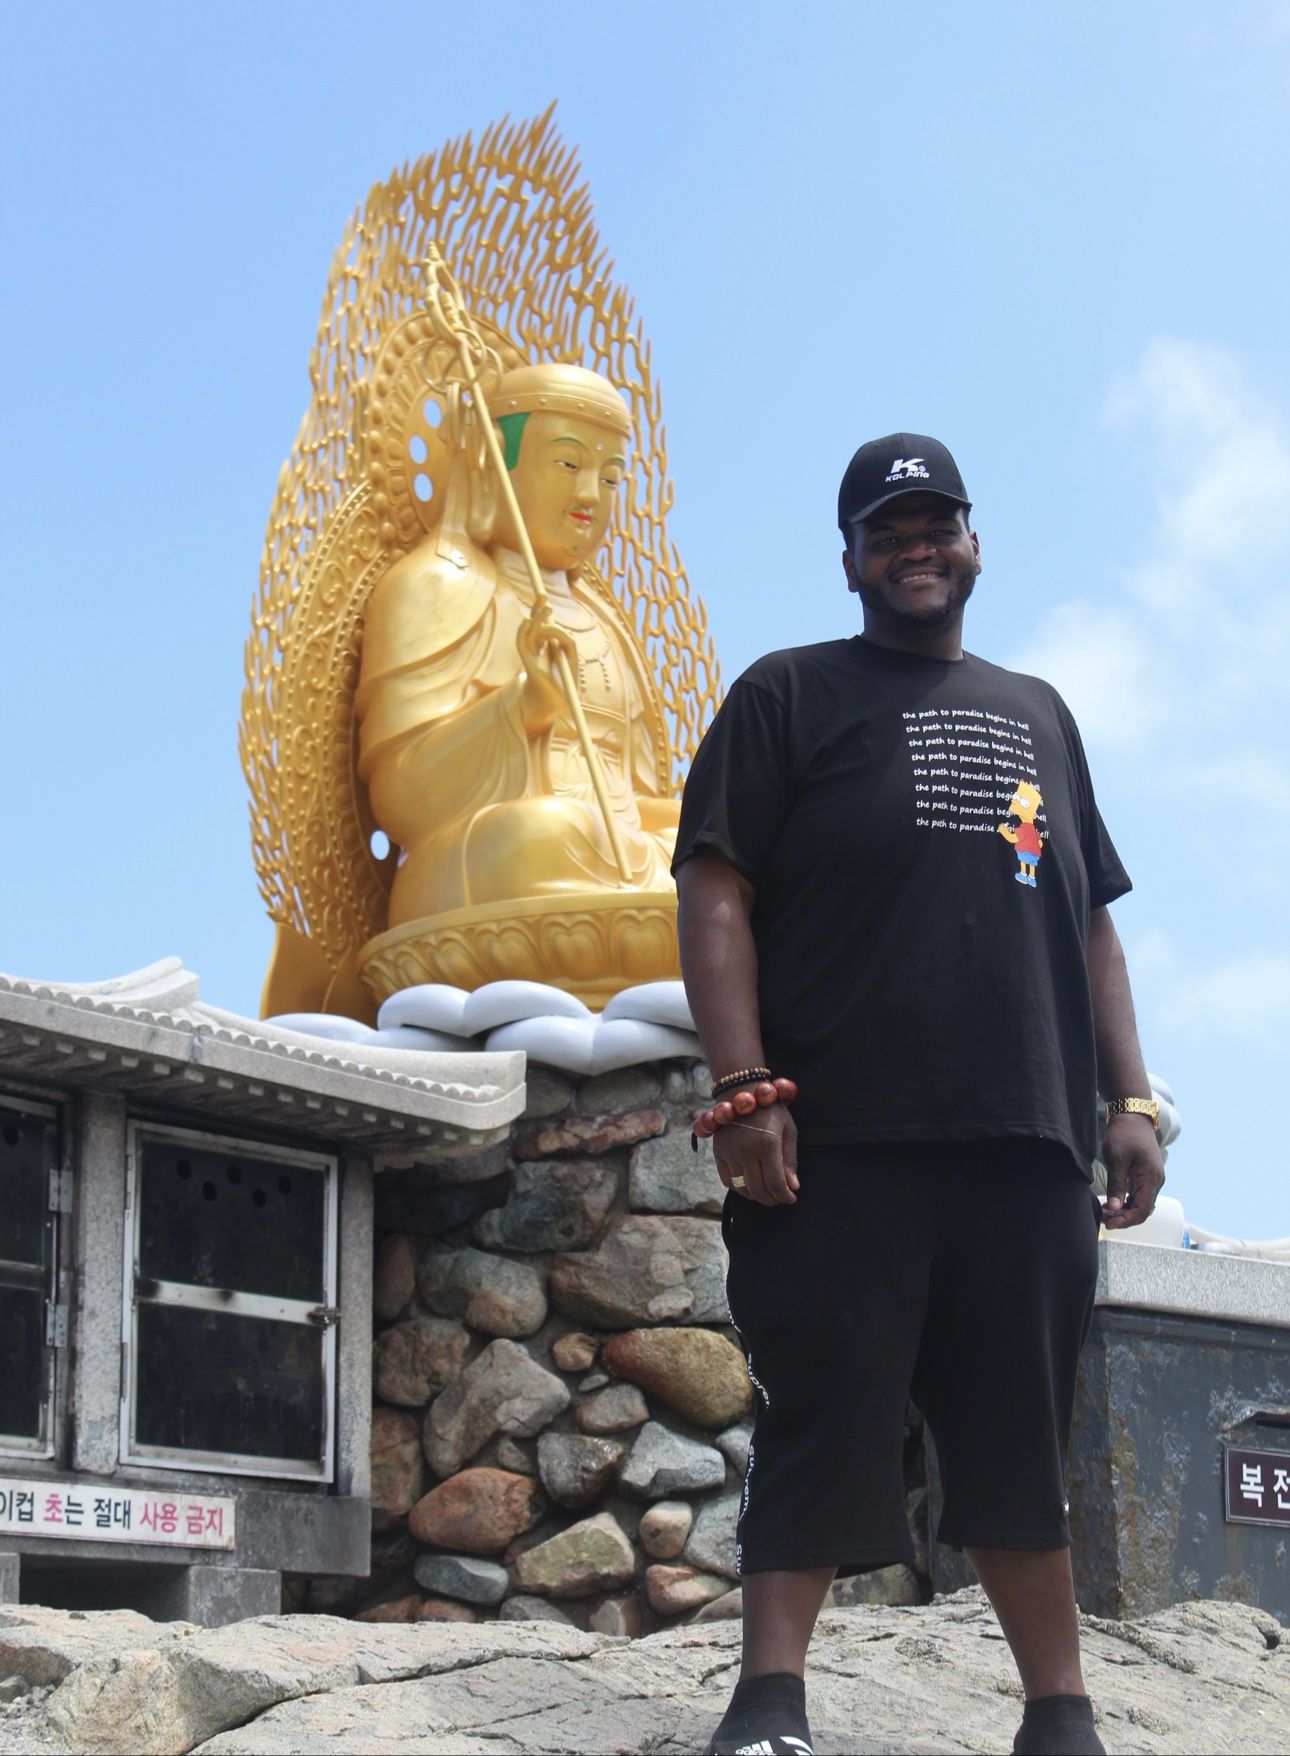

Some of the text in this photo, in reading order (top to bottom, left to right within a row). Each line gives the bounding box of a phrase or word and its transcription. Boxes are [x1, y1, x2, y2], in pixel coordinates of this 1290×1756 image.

[919, 710, 938, 719] path
[952, 709, 983, 718] paradise
[986, 712, 1007, 723] begins
[923, 723, 942, 733] path
[955, 724, 986, 733] paradise
[989, 727, 1010, 738] begins
[909, 739, 923, 747] the
[958, 739, 989, 748] paradise
[992, 741, 1013, 753] begins
[929, 753, 947, 762] path
[950, 753, 957, 761] to
[960, 755, 991, 765] paradise
[994, 757, 1016, 769] begins
[914, 768, 927, 776] the
[931, 768, 948, 777] path
[961, 771, 992, 781] paradise
[996, 773, 1019, 785] begins
[932, 784, 949, 792] path
[961, 788, 993, 798] paradise
[932, 801, 948, 810] path
[950, 804, 957, 812] to
[960, 805, 994, 815] paradise
[917, 818, 929, 826] the
[932, 819, 946, 828] path
[949, 822, 957, 830] to
[960, 823, 994, 832] paradise
[43, 1494, 84, 1525] 초는
[93, 1497, 131, 1529] 절대
[140, 1502, 178, 1533] 사용
[186, 1505, 223, 1536] 금지
